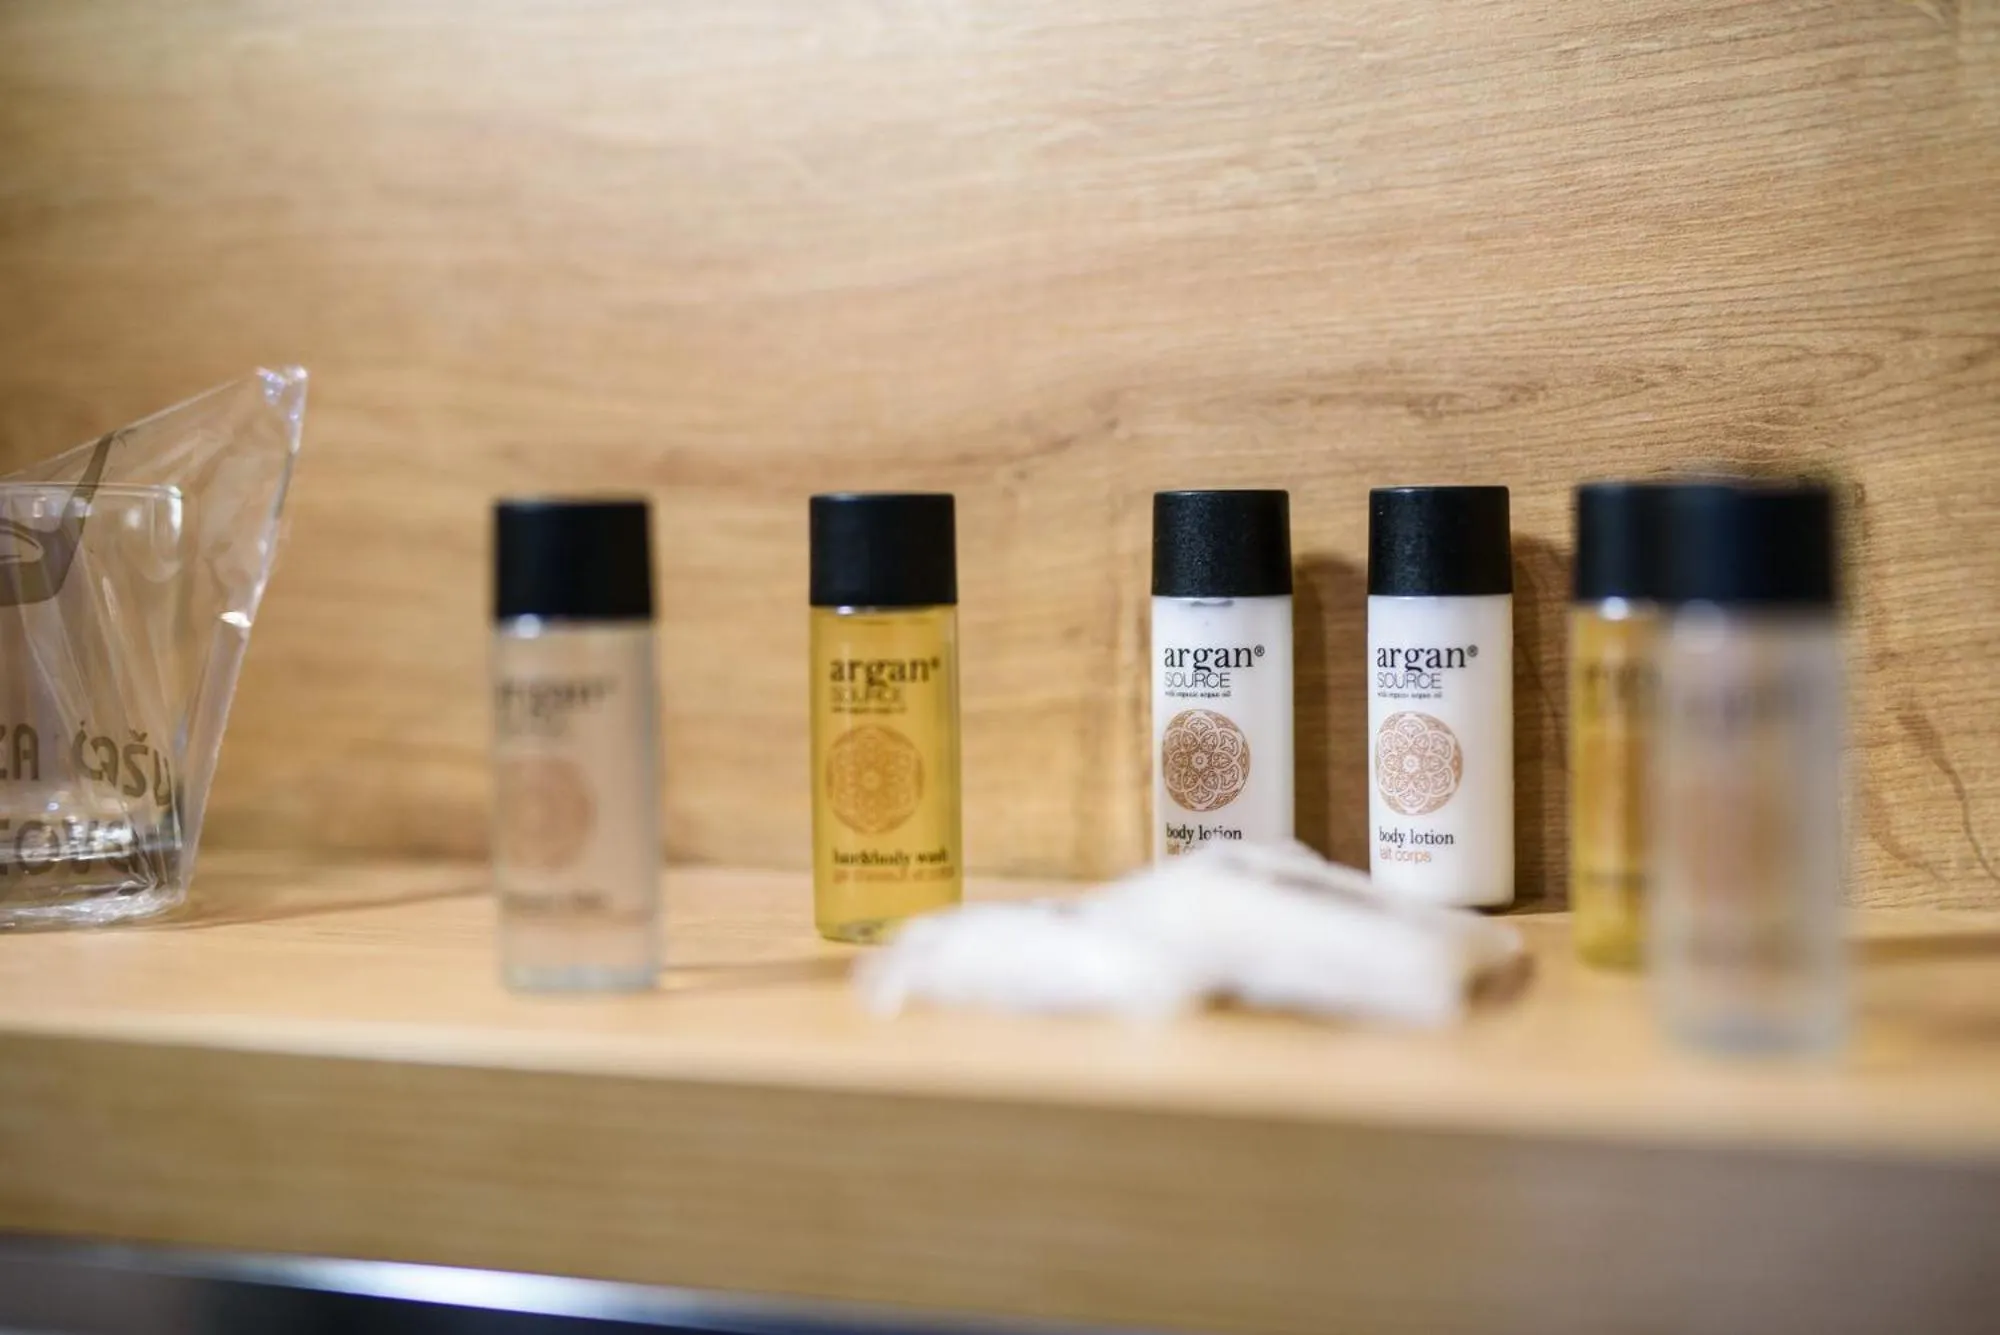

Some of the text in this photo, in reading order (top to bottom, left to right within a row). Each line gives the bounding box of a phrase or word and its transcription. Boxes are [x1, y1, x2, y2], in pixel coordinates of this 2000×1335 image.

[1165, 672, 1231, 688] SOURCE
[1377, 672, 1442, 689] SOURCE
[1166, 822, 1194, 845] body
[1379, 826, 1454, 848] body lotion
